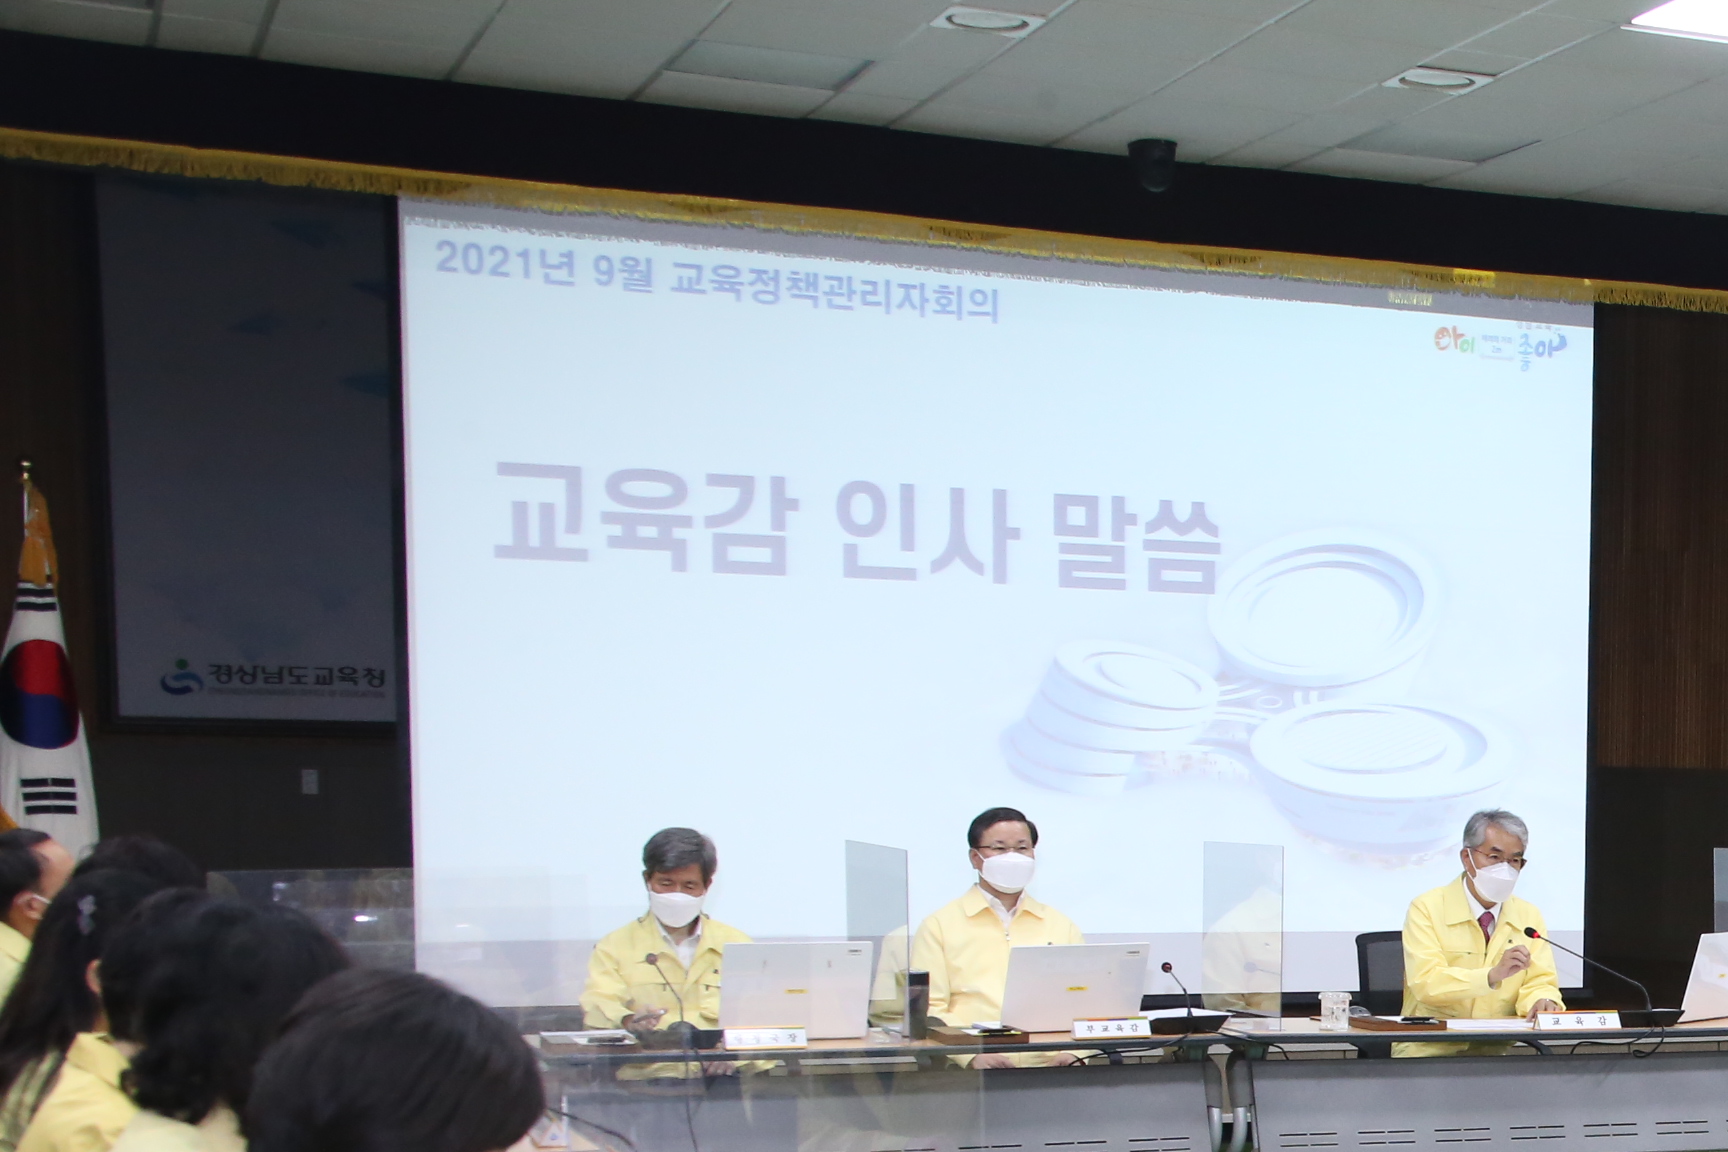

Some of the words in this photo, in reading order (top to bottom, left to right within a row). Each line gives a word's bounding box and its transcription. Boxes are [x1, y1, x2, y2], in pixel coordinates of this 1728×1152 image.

[436, 239, 576, 287] 2021년
[593, 254, 654, 294] 9월
[670, 261, 1000, 324] 교육정책관리자회의
[494, 461, 799, 577] 교육감
[835, 480, 1021, 585] 인사
[1053, 493, 1221, 595] 말씀
[208, 663, 386, 688] 경상남도교육청
[1086, 1023, 1139, 1034] 부교육감
[1551, 1015, 1608, 1026] 교육감
